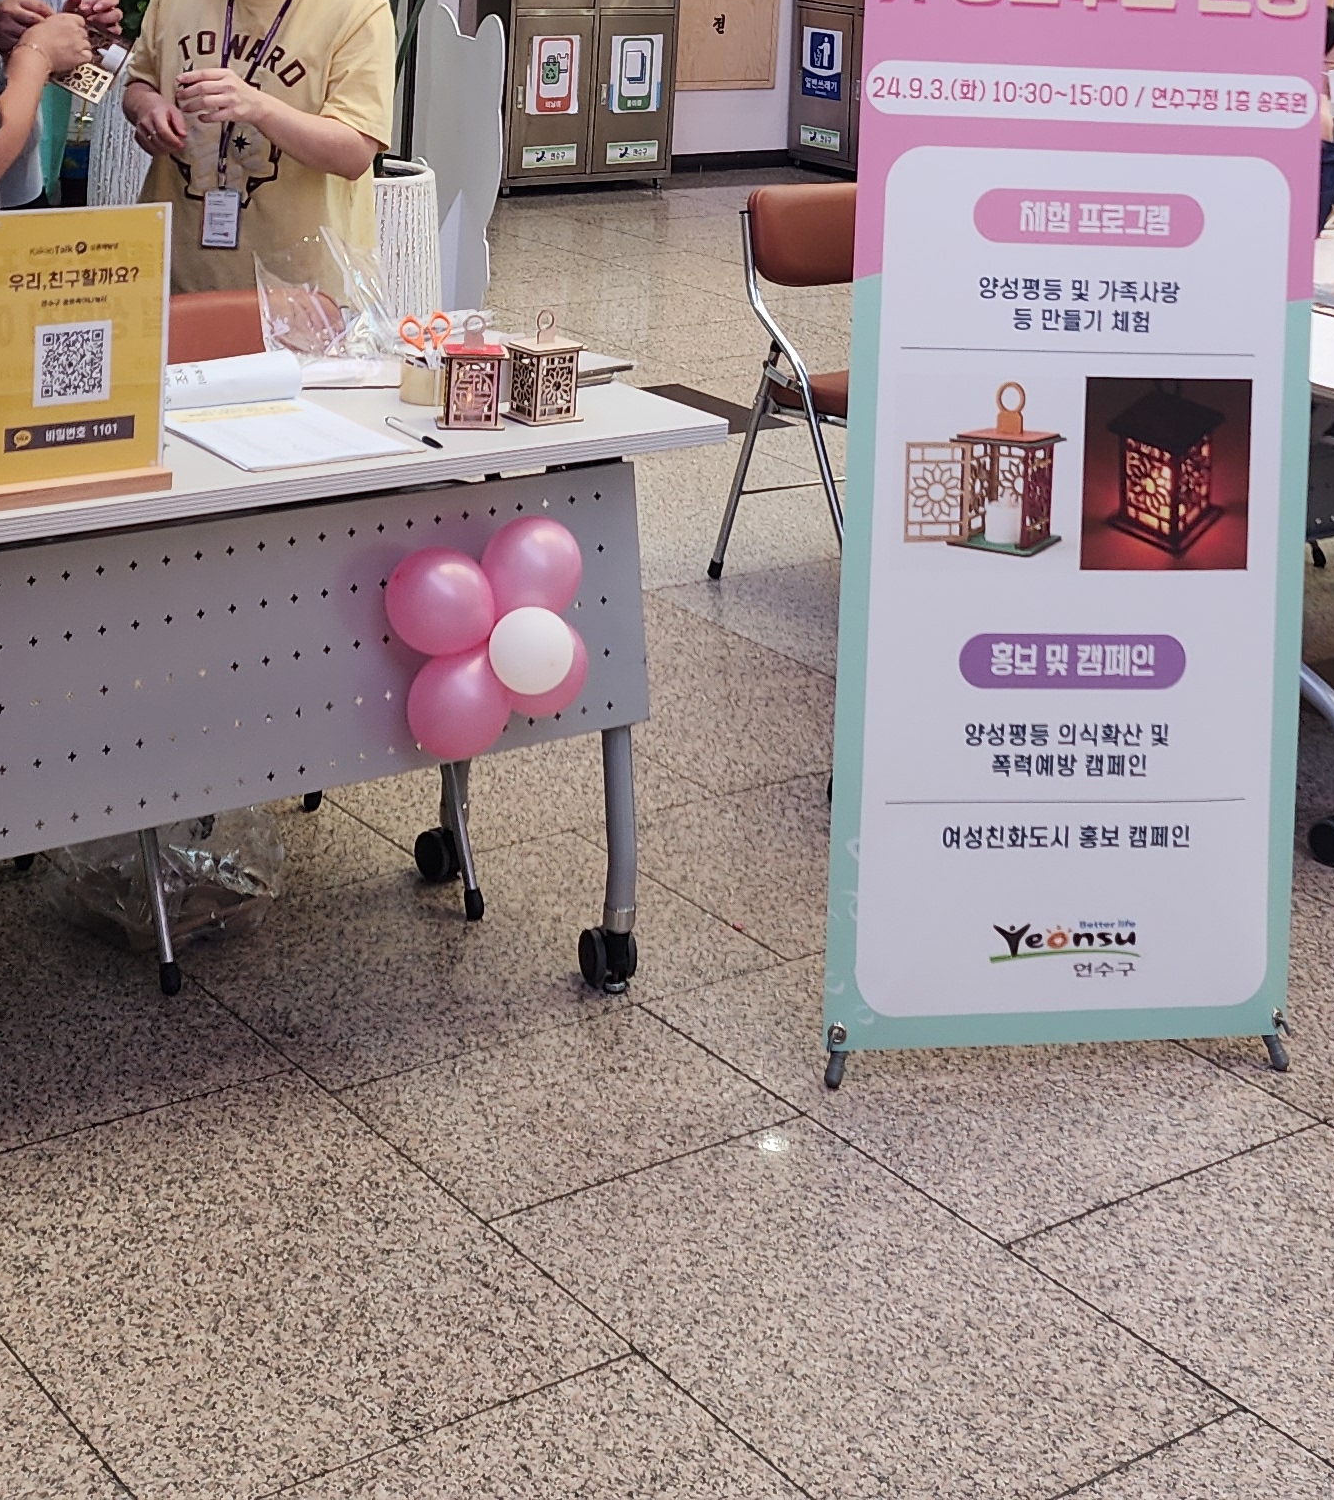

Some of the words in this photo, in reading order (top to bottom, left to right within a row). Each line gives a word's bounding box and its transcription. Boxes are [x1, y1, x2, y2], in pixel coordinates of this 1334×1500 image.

[178, 31, 306, 88] TOWARD
[805, 77, 837, 92] 일반쓰레기
[872, 76, 986, 103] 24.9.3.(화)
[992, 80, 1129, 107] 10:30~15:00
[1019, 199, 1070, 234] 체험
[1077, 201, 1171, 236] 프로그램
[978, 275, 1063, 302] 양성평등
[1070, 278, 1091, 302] 및
[1097, 279, 1181, 304] 가족사랑
[1012, 308, 1033, 331] 등
[1041, 308, 1103, 333] 만들기
[1111, 310, 1151, 333] 체험
[45, 425, 86, 442] 비밀번호
[92, 423, 118, 436] 1101
[990, 641, 1038, 677] 홍보
[1045, 642, 1069, 677] 및
[1076, 643, 1156, 677] 캠페인
[964, 723, 1050, 748] 양성평등
[1057, 723, 1142, 748] 의식확산
[1150, 723, 1170, 748] 및
[991, 752, 1077, 778] 폭력예방
[1085, 753, 1148, 778] 캠페인
[942, 825, 1070, 850] 여성친화도시
[1078, 825, 1120, 849] 홍보
[1128, 825, 1191, 849] 캠페인
[992, 922, 1138, 957] Yeonsu
[1073, 962, 1136, 977] 연수구
